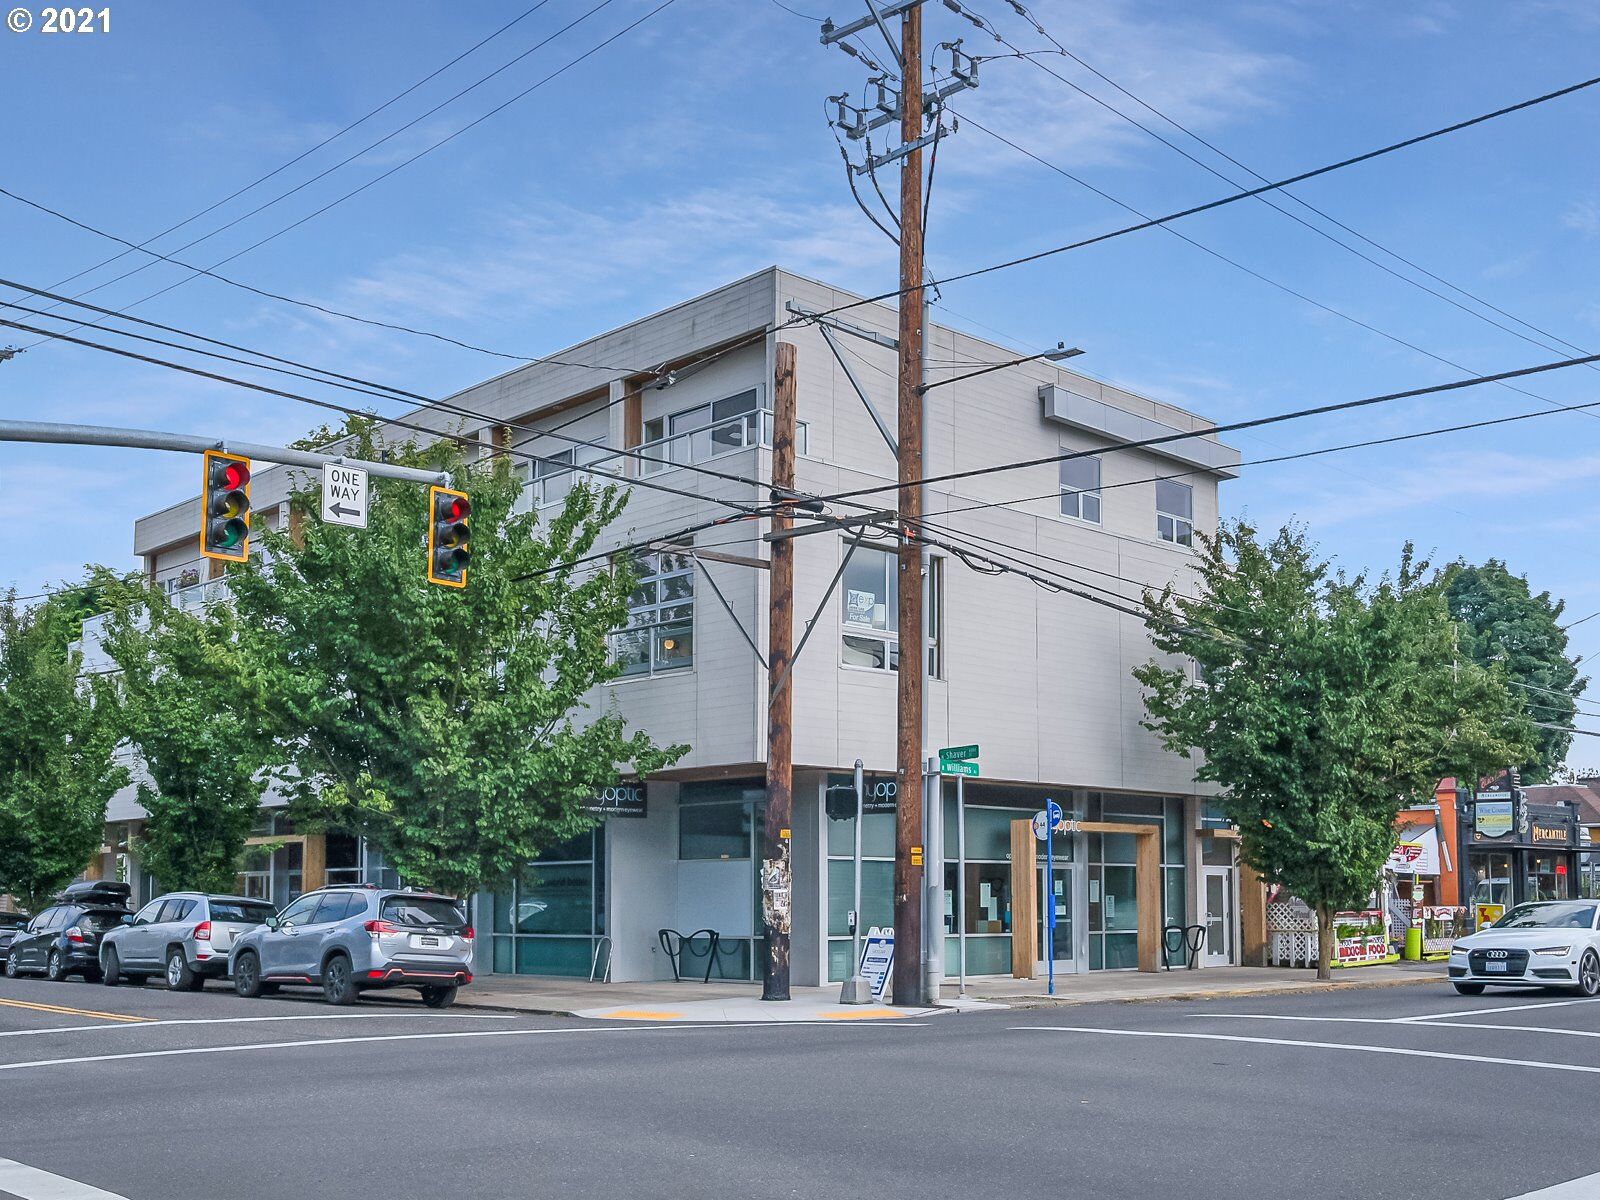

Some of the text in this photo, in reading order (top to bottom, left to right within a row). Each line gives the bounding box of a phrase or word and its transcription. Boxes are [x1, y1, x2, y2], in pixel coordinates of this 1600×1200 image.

[331, 470, 360, 487] ONE
[330, 484, 360, 502] WAY
[946, 750, 966, 760] Shaver
[946, 763, 972, 774] Williams
[594, 785, 643, 806] yoptic
[1368, 943, 1386, 955] FOOD
